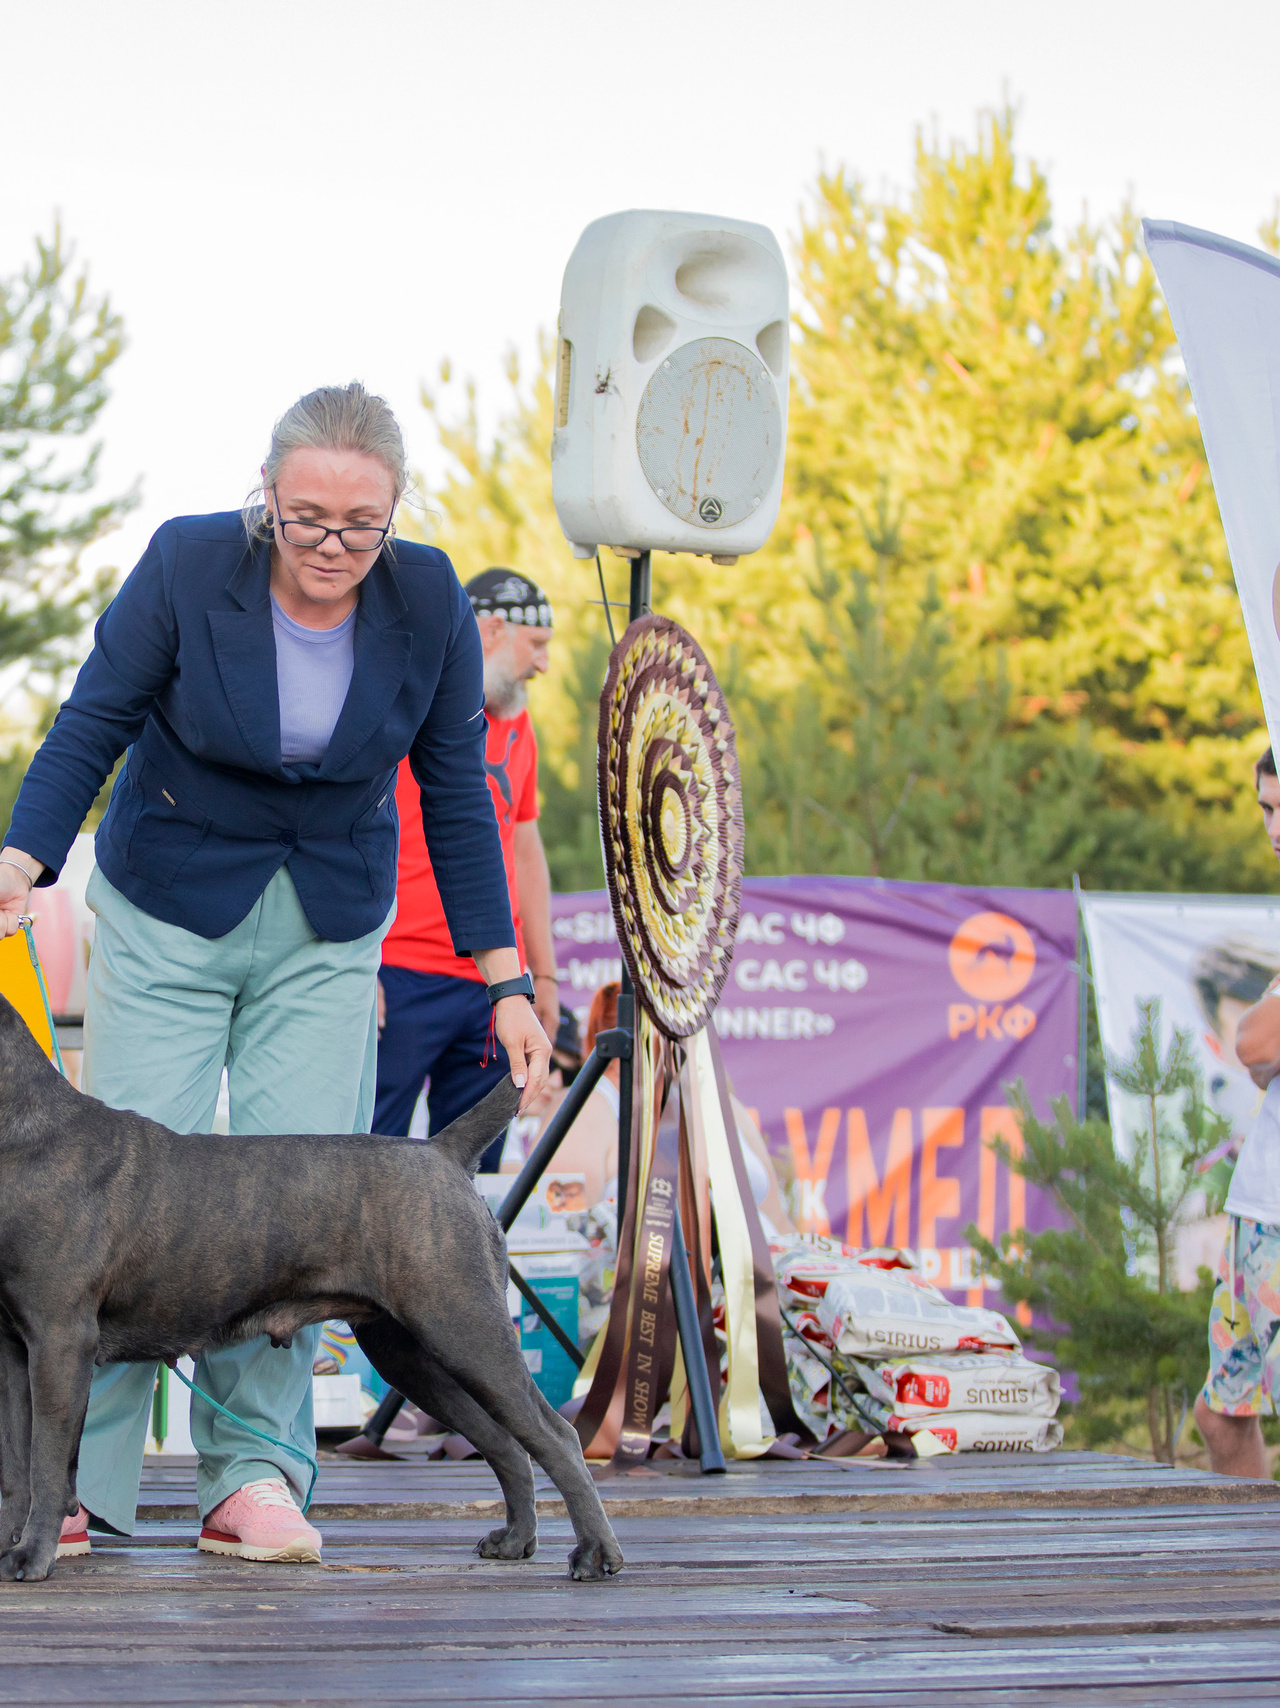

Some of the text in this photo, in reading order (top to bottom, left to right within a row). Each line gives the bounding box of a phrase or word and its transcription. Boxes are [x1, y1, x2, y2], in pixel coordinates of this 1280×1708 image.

[713, 1006, 836, 1040] NNER»
[948, 1003, 1037, 1041] РКФ
[642, 1231, 665, 1304] SUPREME
[639, 1309, 657, 1348] BEST
[874, 1330, 941, 1350] SIRIUS
[637, 1354, 653, 1375] IN
[632, 1378, 650, 1428] SHOW
[967, 1388, 1028, 1403] SIRIUS
